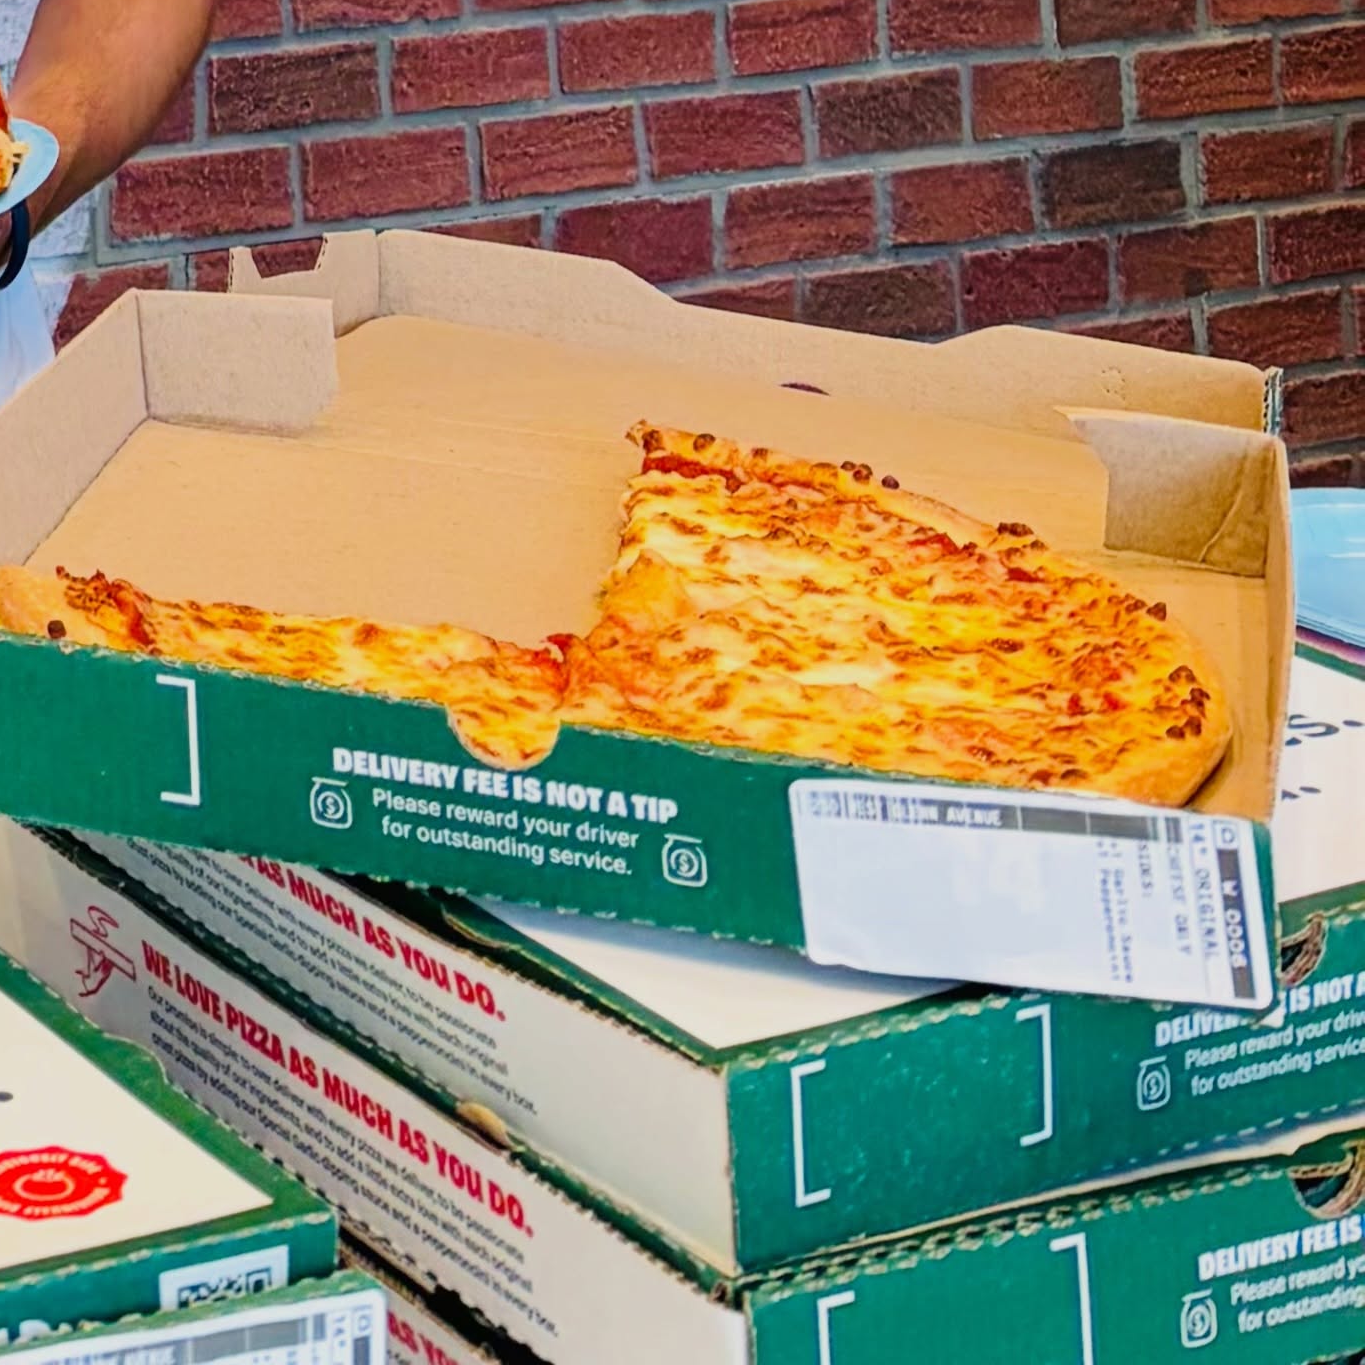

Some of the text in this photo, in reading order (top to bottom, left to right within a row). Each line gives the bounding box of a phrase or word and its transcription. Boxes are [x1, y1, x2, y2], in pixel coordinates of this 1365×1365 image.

[333, 747, 678, 825] DELIVERY FEE IS NOT A TIP
[373, 788, 639, 848] Please reward your driver
[381, 815, 633, 875] for outstanding service.
[287, 869, 360, 938] MUCH
[362, 916, 396, 959] AS
[395, 935, 452, 993] YOU
[453, 969, 506, 1022] DO.
[1289, 986, 1311, 1014] IS
[1313, 974, 1354, 1006] NOT
[1185, 1043, 1237, 1070] Please
[1240, 1025, 1293, 1056] reward
[1295, 1019, 1330, 1046] your
[1191, 1075, 1215, 1097] for
[1217, 1051, 1312, 1090] outstanding
[141, 939, 533, 1239] WE LOVE PIZZA AS MUCH AS YOU DO.
[1198, 1214, 1362, 1282] DELIVERY FEE IS
[1230, 1255, 1346, 1306] Please reward
[1238, 1308, 1264, 1333] for
